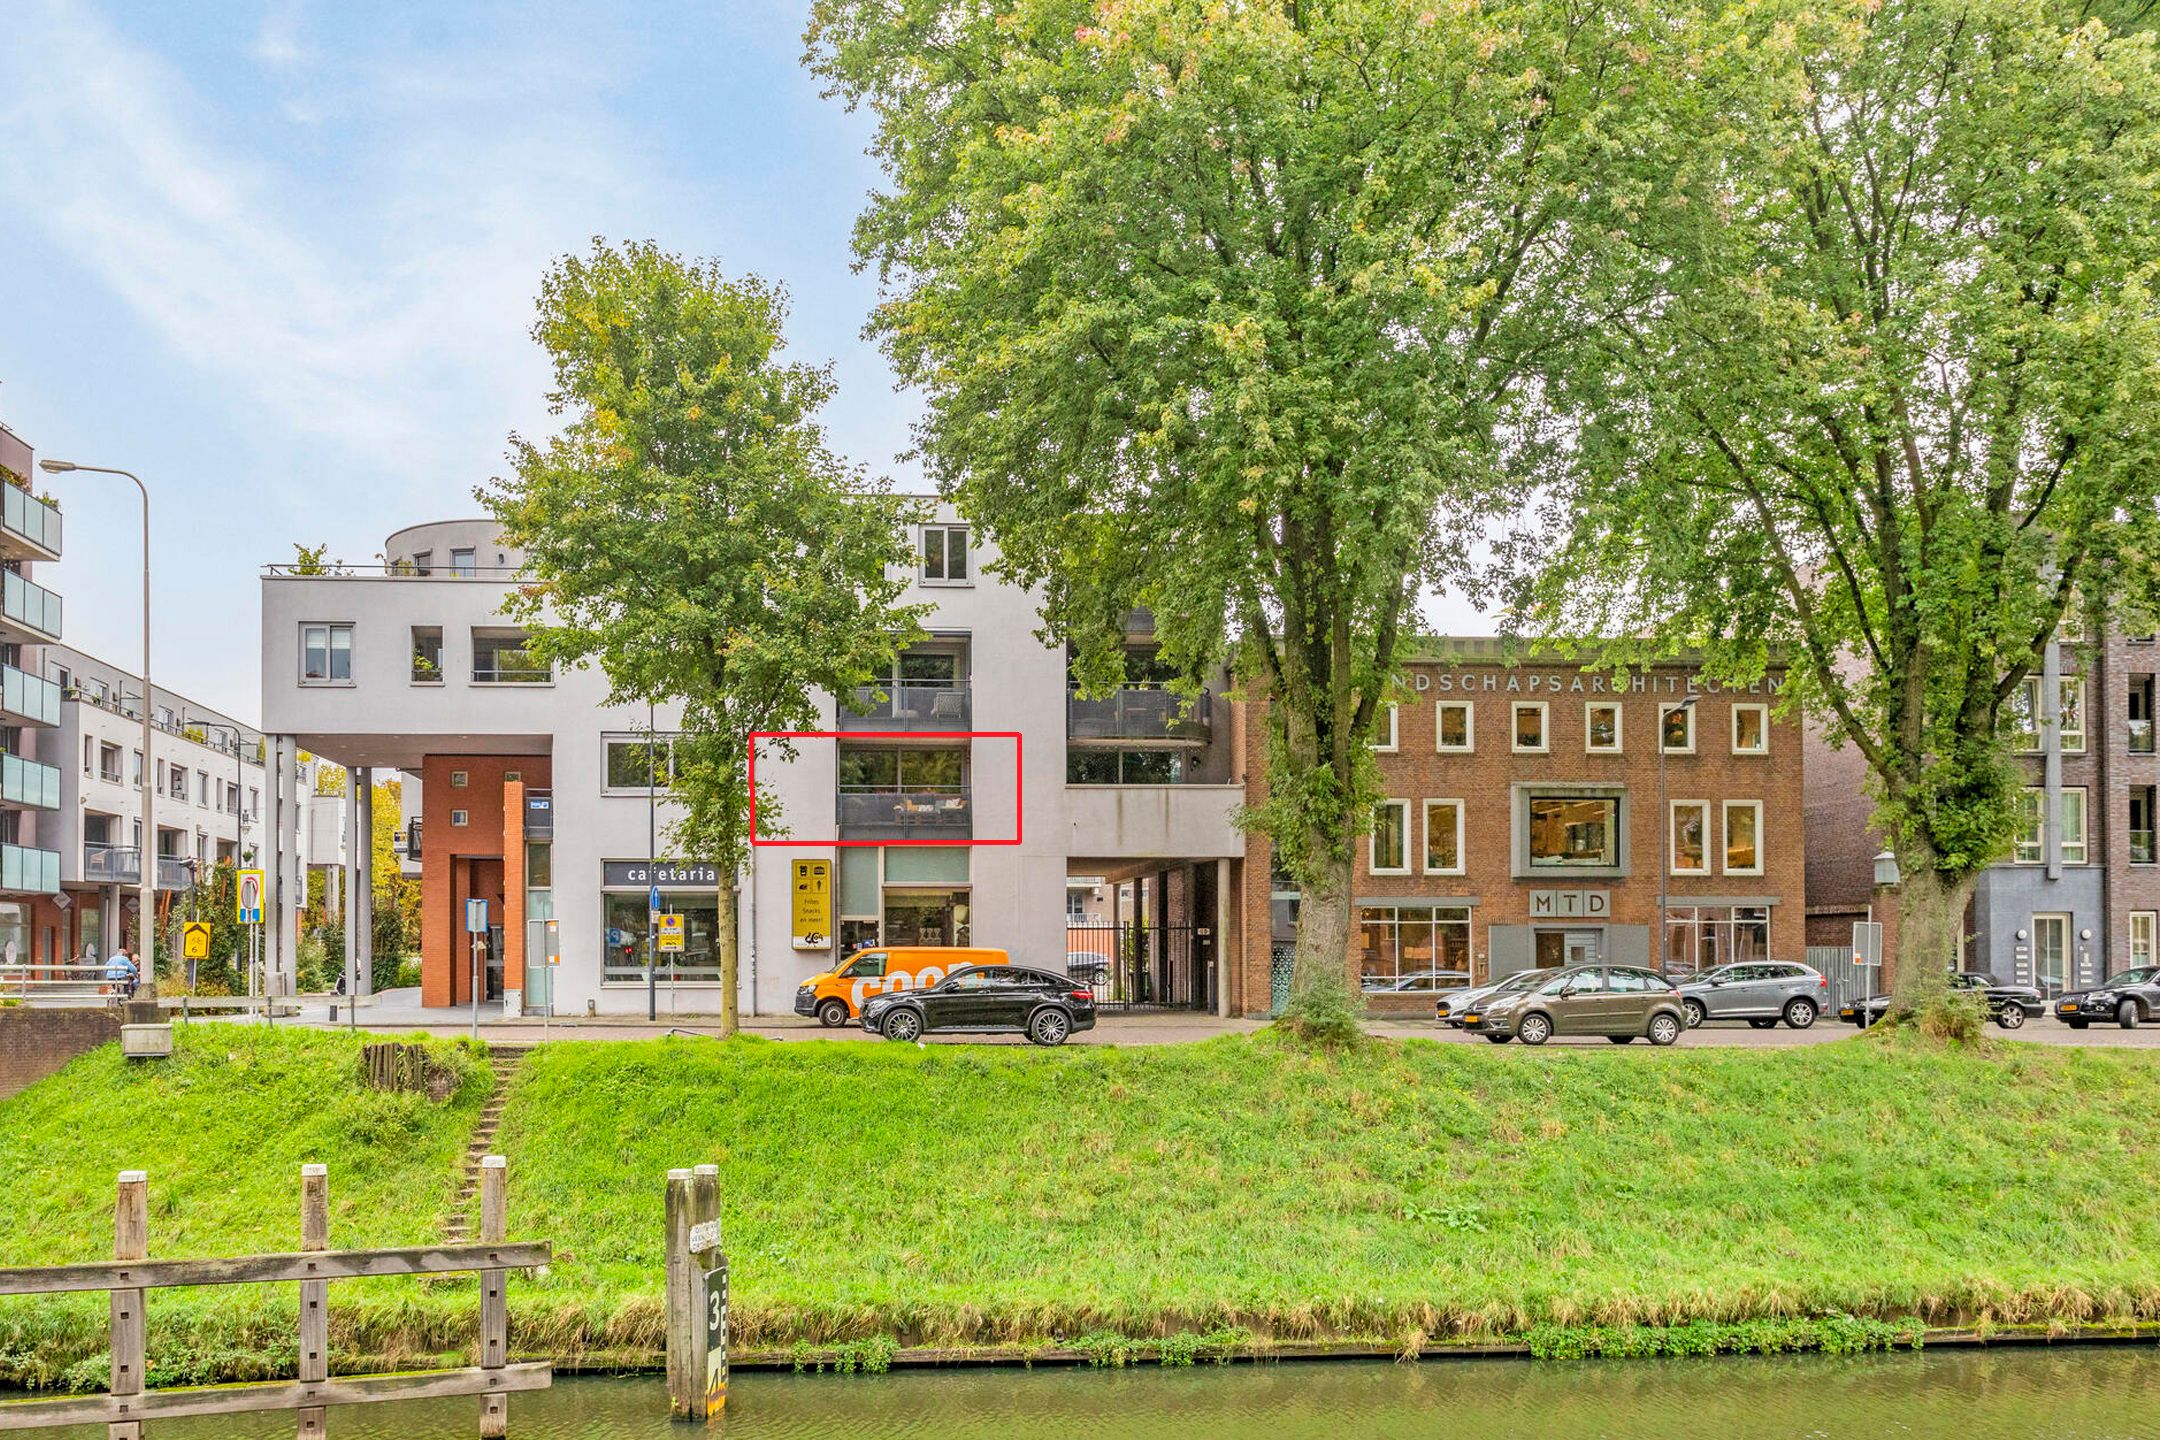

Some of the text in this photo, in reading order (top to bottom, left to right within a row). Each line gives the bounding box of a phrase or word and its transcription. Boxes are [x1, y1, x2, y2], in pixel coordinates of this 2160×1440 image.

[1391, 674, 1784, 693] NDSCHAPSARHITECEN
[627, 866, 715, 881] caetaria
[1536, 895, 1604, 912] MTD
[709, 1290, 720, 1331] 3
